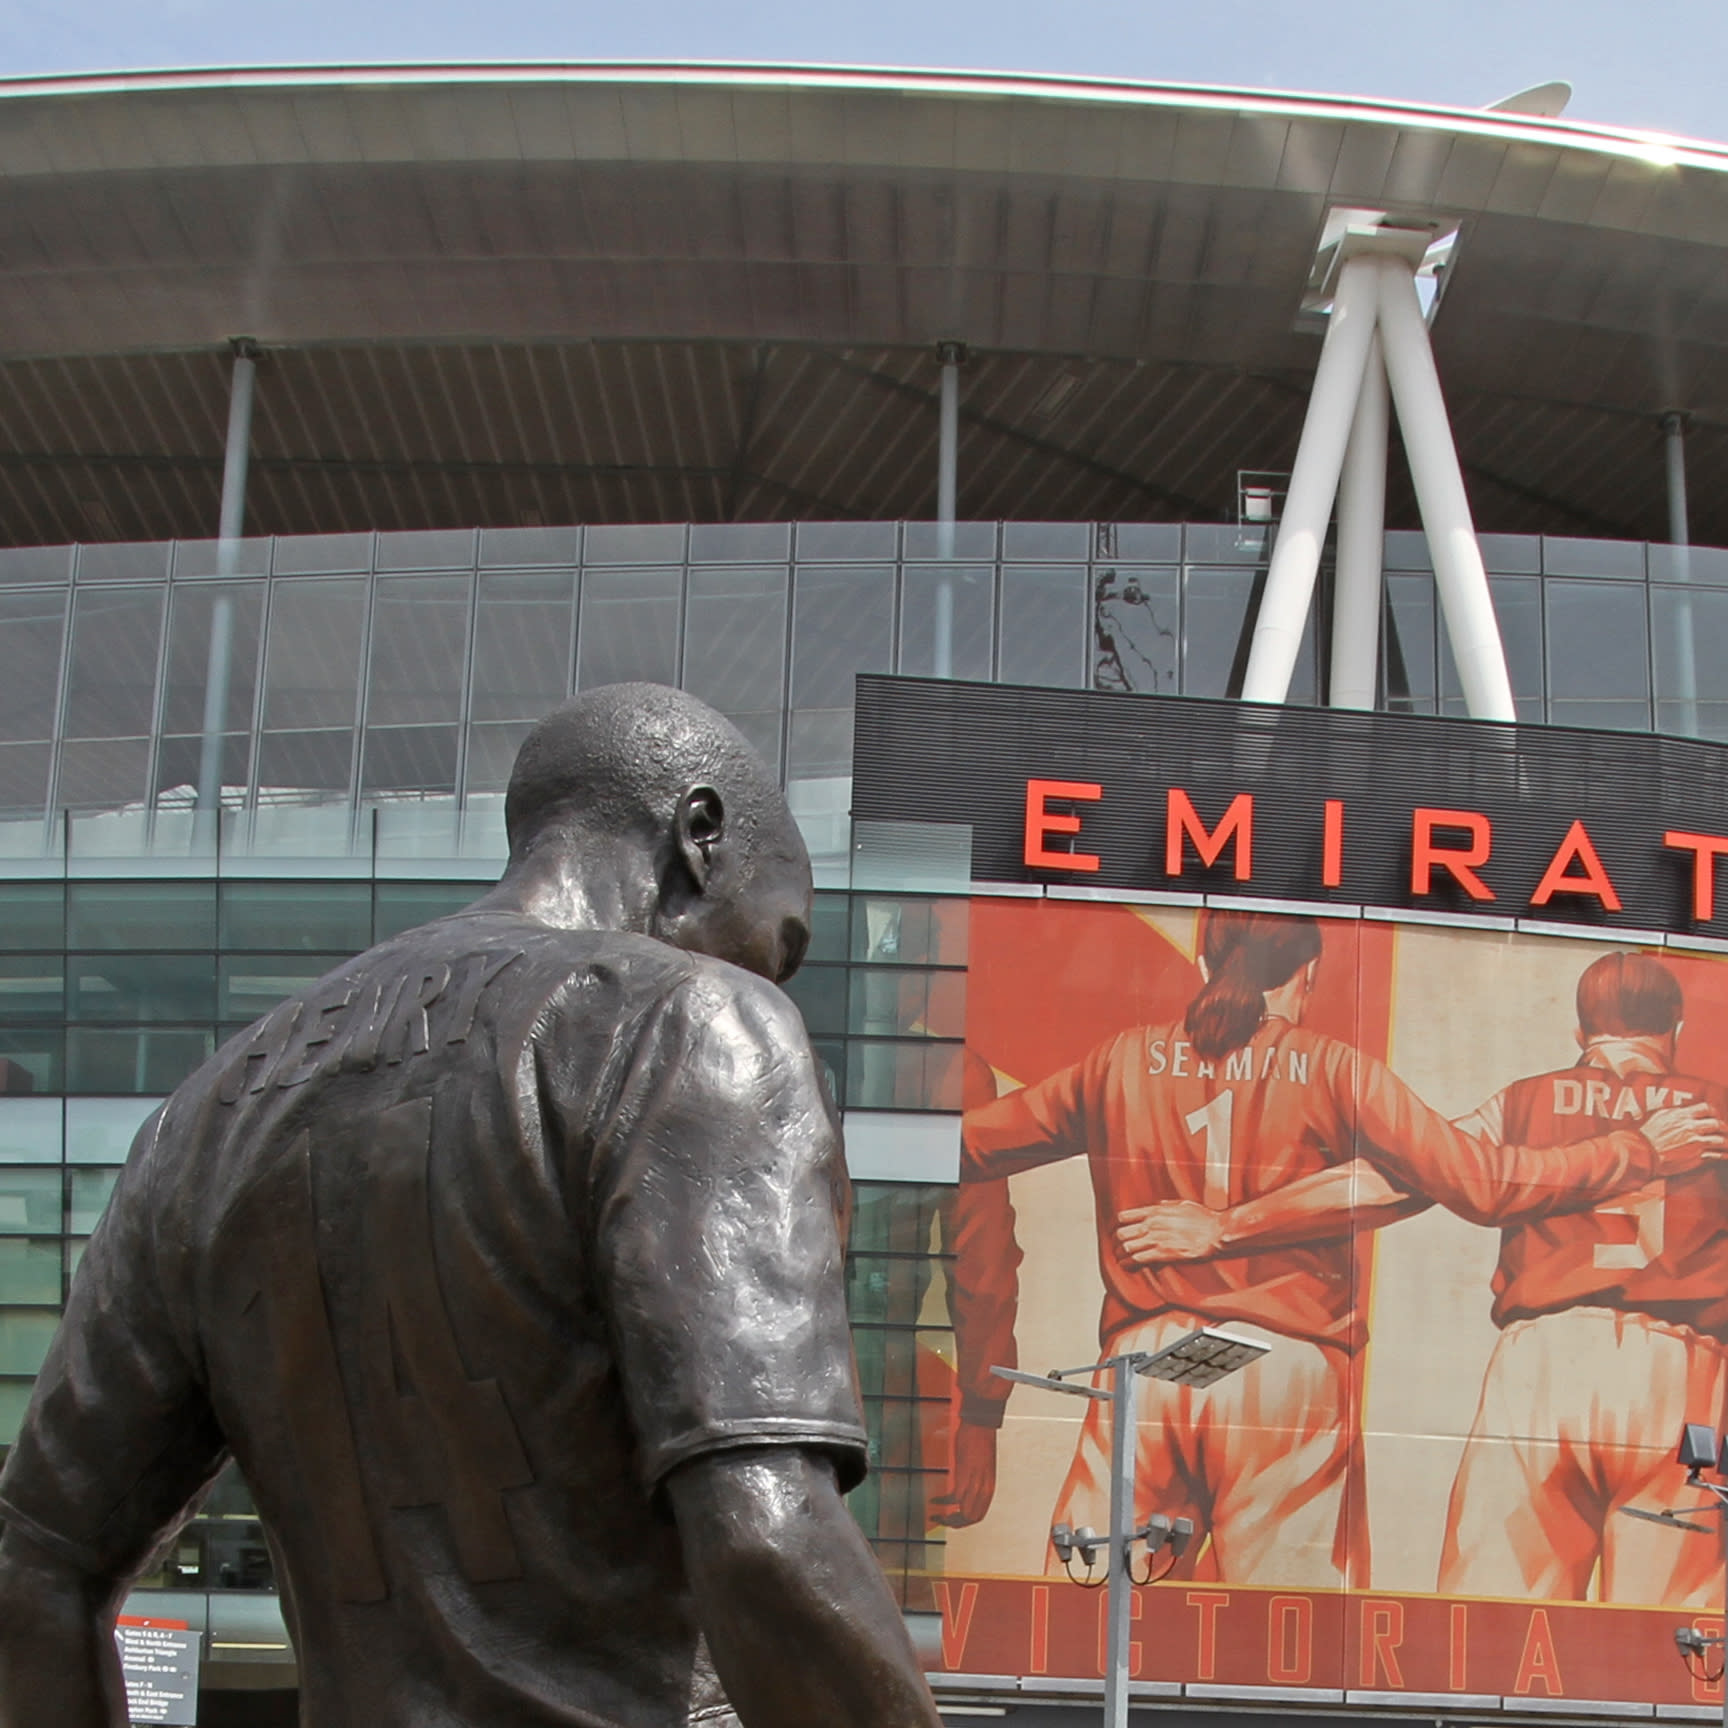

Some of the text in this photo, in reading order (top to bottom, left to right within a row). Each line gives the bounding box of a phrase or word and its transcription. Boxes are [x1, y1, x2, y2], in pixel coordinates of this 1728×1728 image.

[219, 949, 525, 1106] HENRY
[1148, 1040, 1309, 1085] SEAMAN
[1186, 1089, 1234, 1211] 1
[932, 1582, 1564, 1696] VICTORIA
